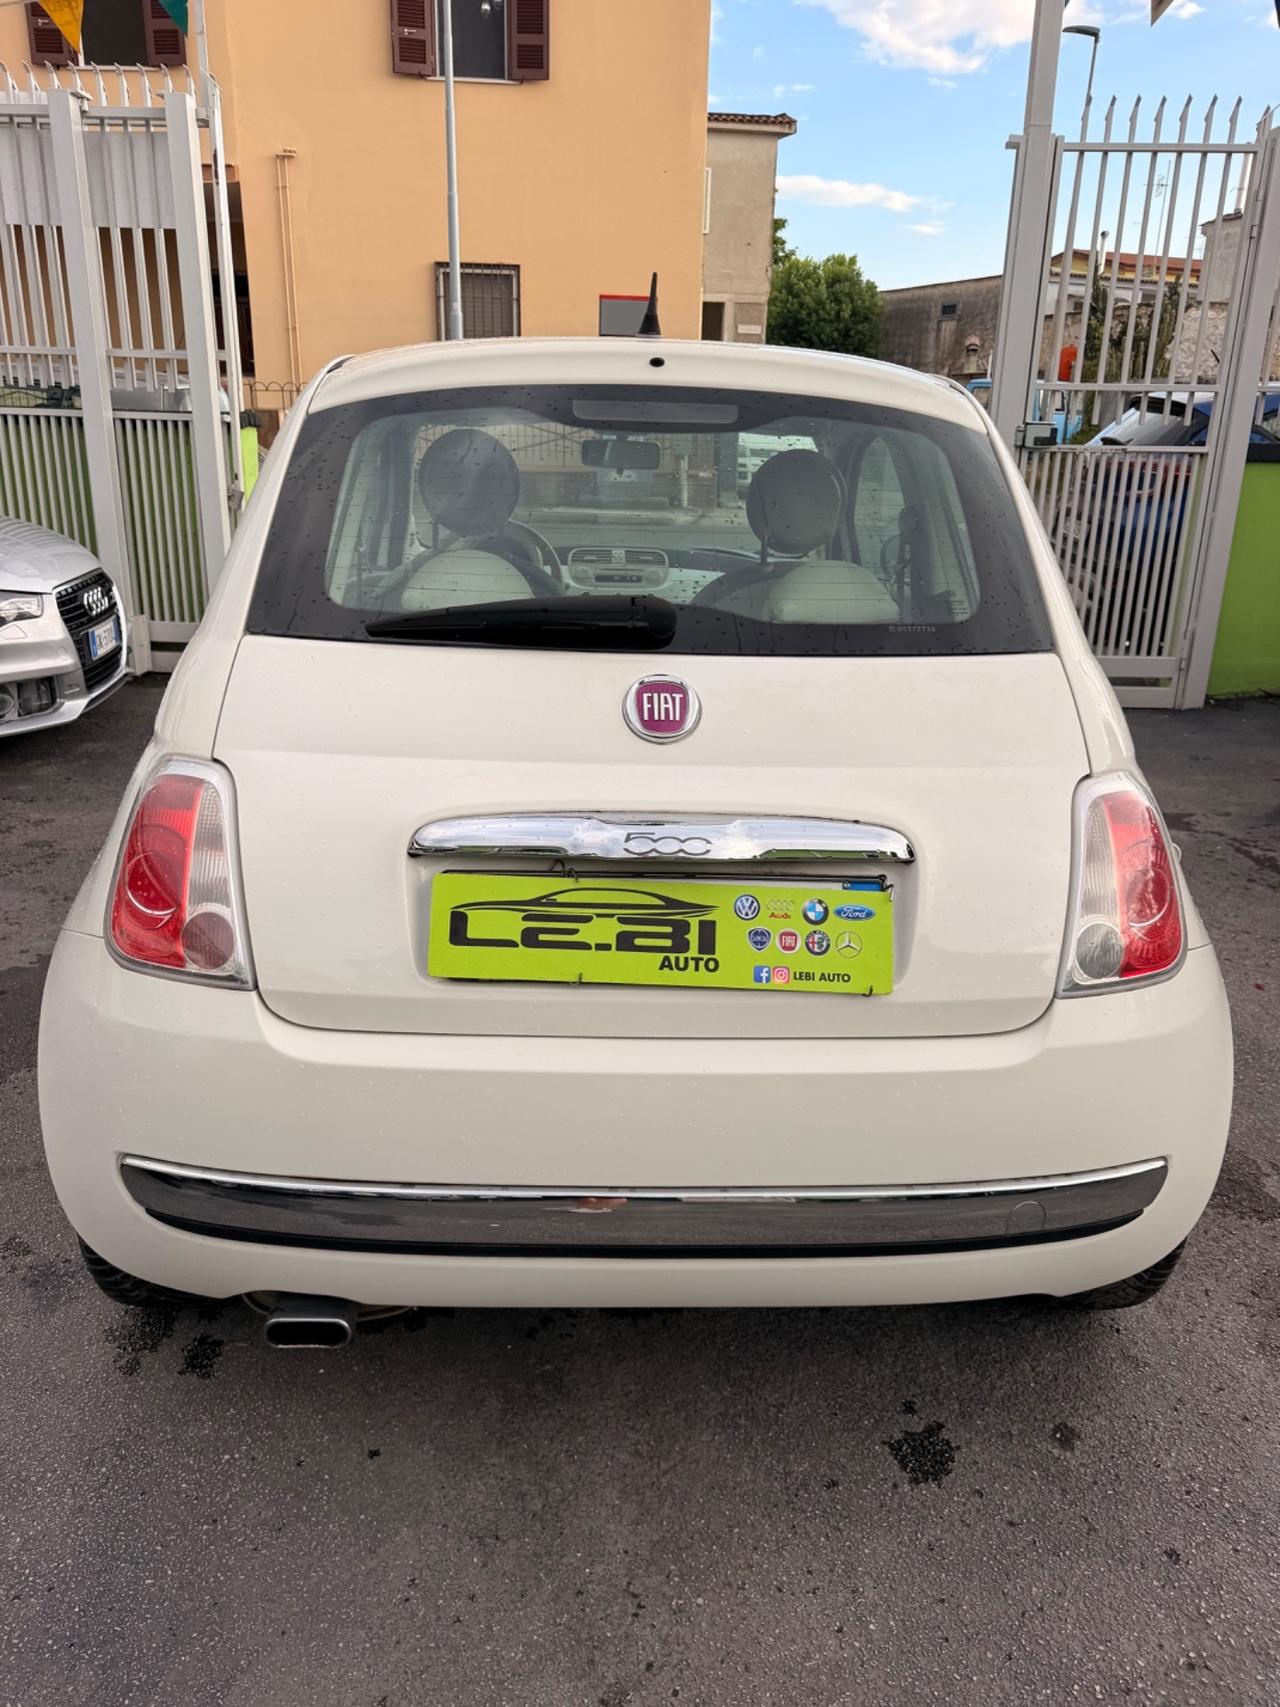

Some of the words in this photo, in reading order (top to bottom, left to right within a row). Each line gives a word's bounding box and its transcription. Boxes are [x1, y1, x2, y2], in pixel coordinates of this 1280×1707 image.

[642, 692, 684, 721] FIAT
[623, 832, 712, 857] 500
[840, 907, 867, 919] Ford
[658, 955, 720, 973] AUTO
[793, 971, 815, 982] LEBI
[818, 972, 852, 983] AUTO
